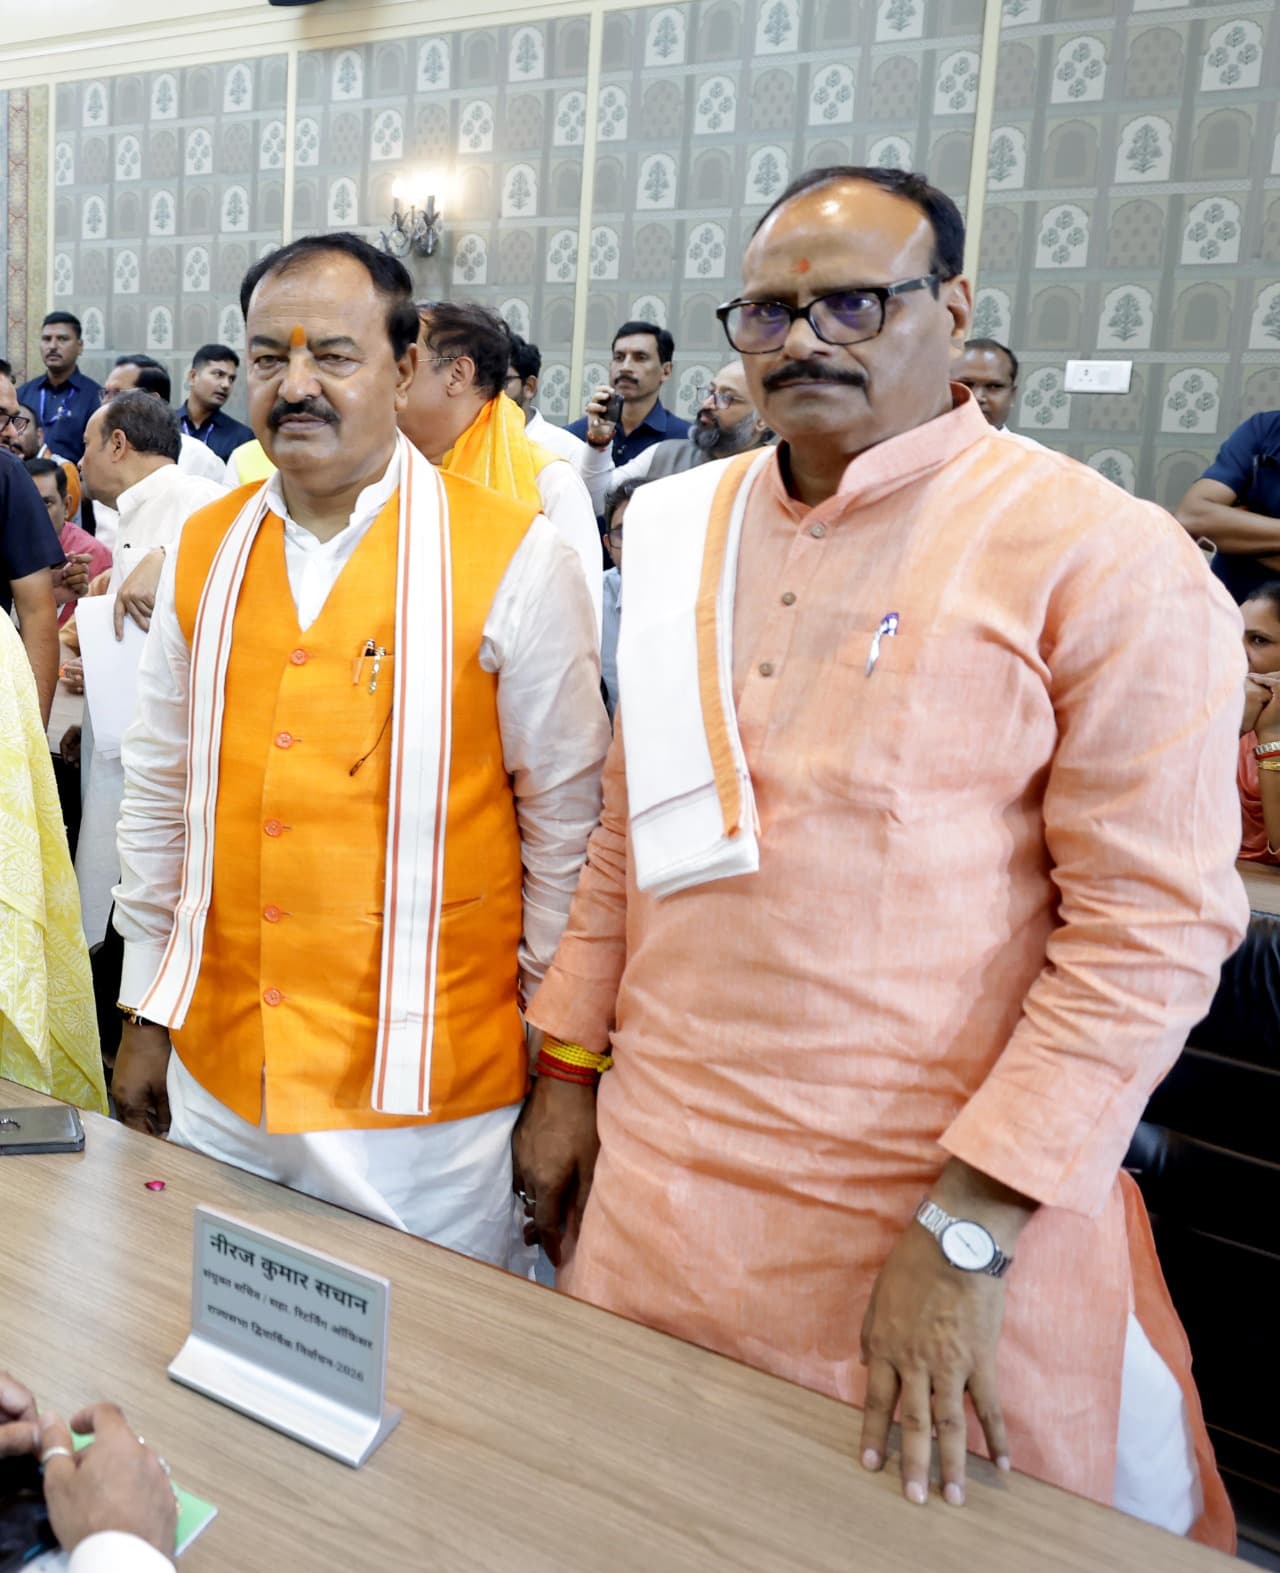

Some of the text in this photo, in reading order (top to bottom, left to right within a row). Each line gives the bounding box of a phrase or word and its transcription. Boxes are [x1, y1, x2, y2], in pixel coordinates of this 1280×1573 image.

[209, 1233, 368, 1315] नीरज कुमार सचान
